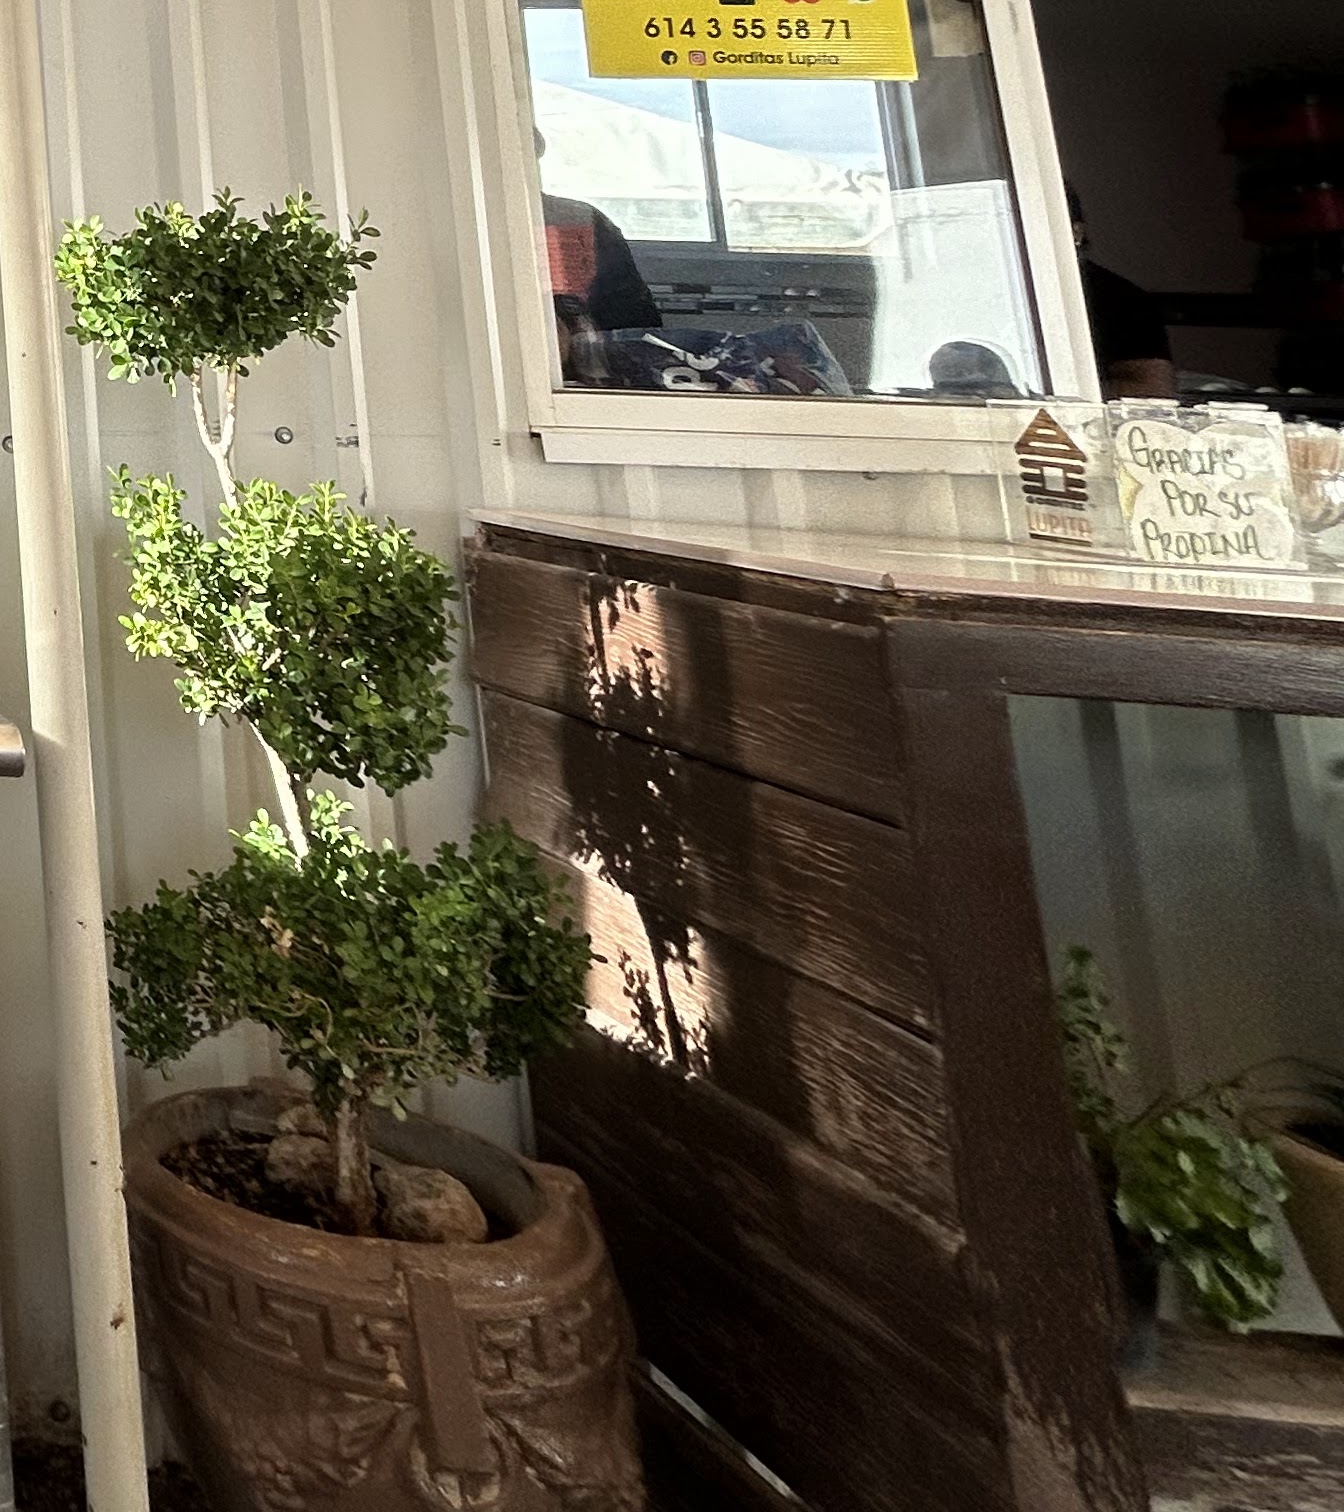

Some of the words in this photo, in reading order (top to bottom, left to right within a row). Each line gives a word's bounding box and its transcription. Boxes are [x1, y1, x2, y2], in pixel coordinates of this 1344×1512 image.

[645, 18, 695, 39] 614
[706, 18, 722, 39] 3
[732, 18, 766, 39] 55
[776, 19, 811, 39] 58
[821, 19, 852, 39] 71
[713, 50, 784, 64] Gorditas
[789, 50, 840, 67] Lupita
[1161, 479, 1221, 517] POR
[1218, 490, 1265, 520] SU
[1141, 518, 1275, 562] PROPINA
